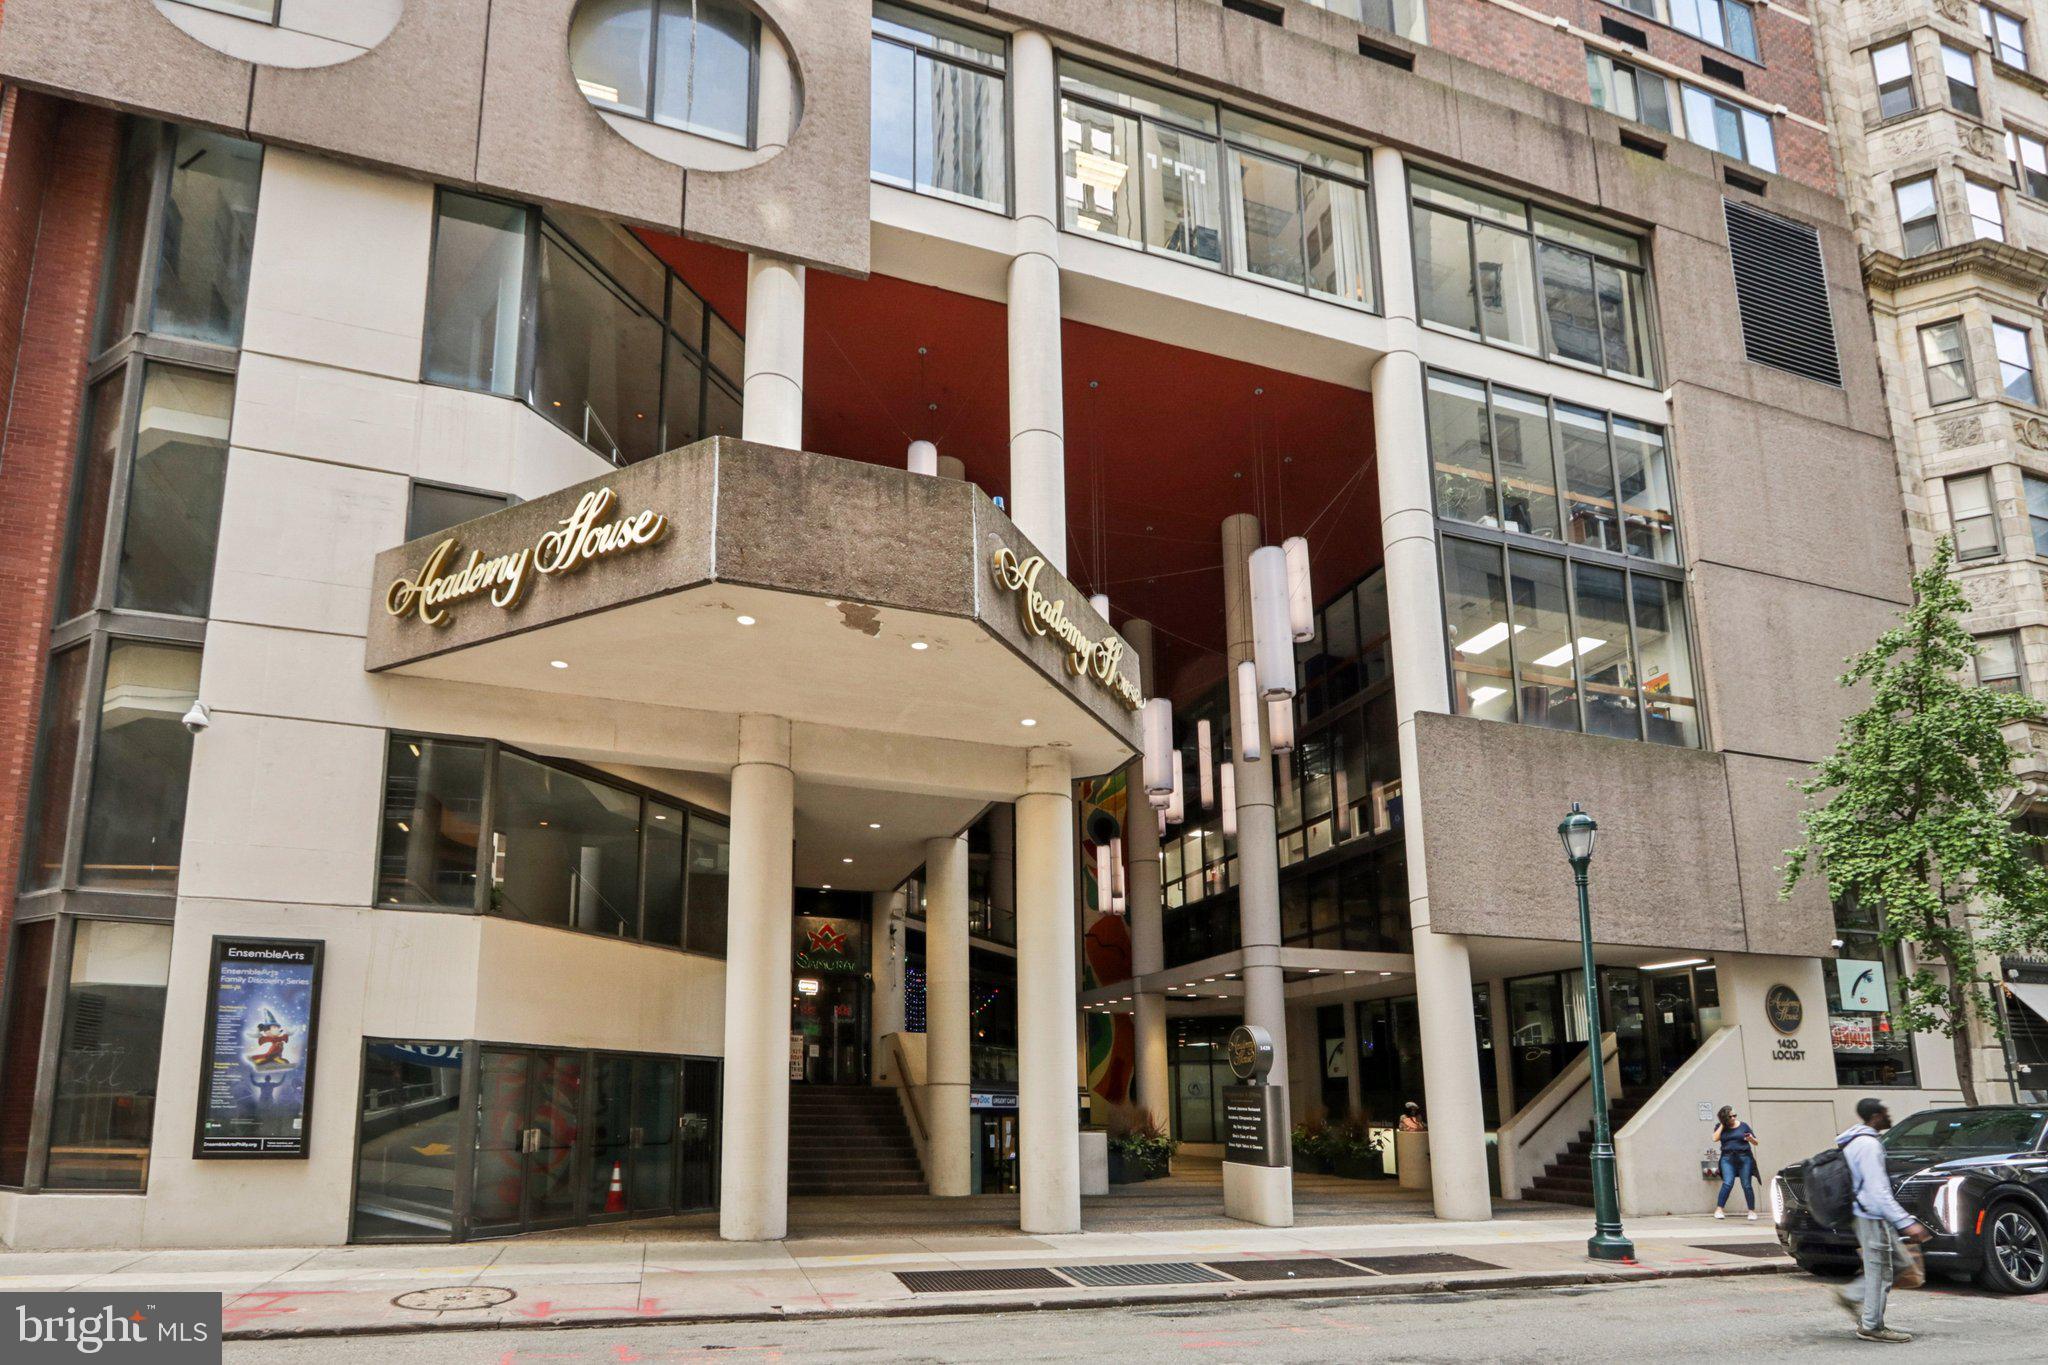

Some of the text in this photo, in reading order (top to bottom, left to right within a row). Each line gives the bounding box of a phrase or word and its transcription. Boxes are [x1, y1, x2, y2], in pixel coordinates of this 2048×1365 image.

[385, 487, 668, 626] Academy House
[994, 547, 1092, 677] Academy
[227, 947, 305, 960] EnsembleArts
[220, 975, 311, 986] Family Discovery Series
[1776, 1039, 1799, 1050] 1420
[1772, 1049, 1806, 1061] LOCUST
